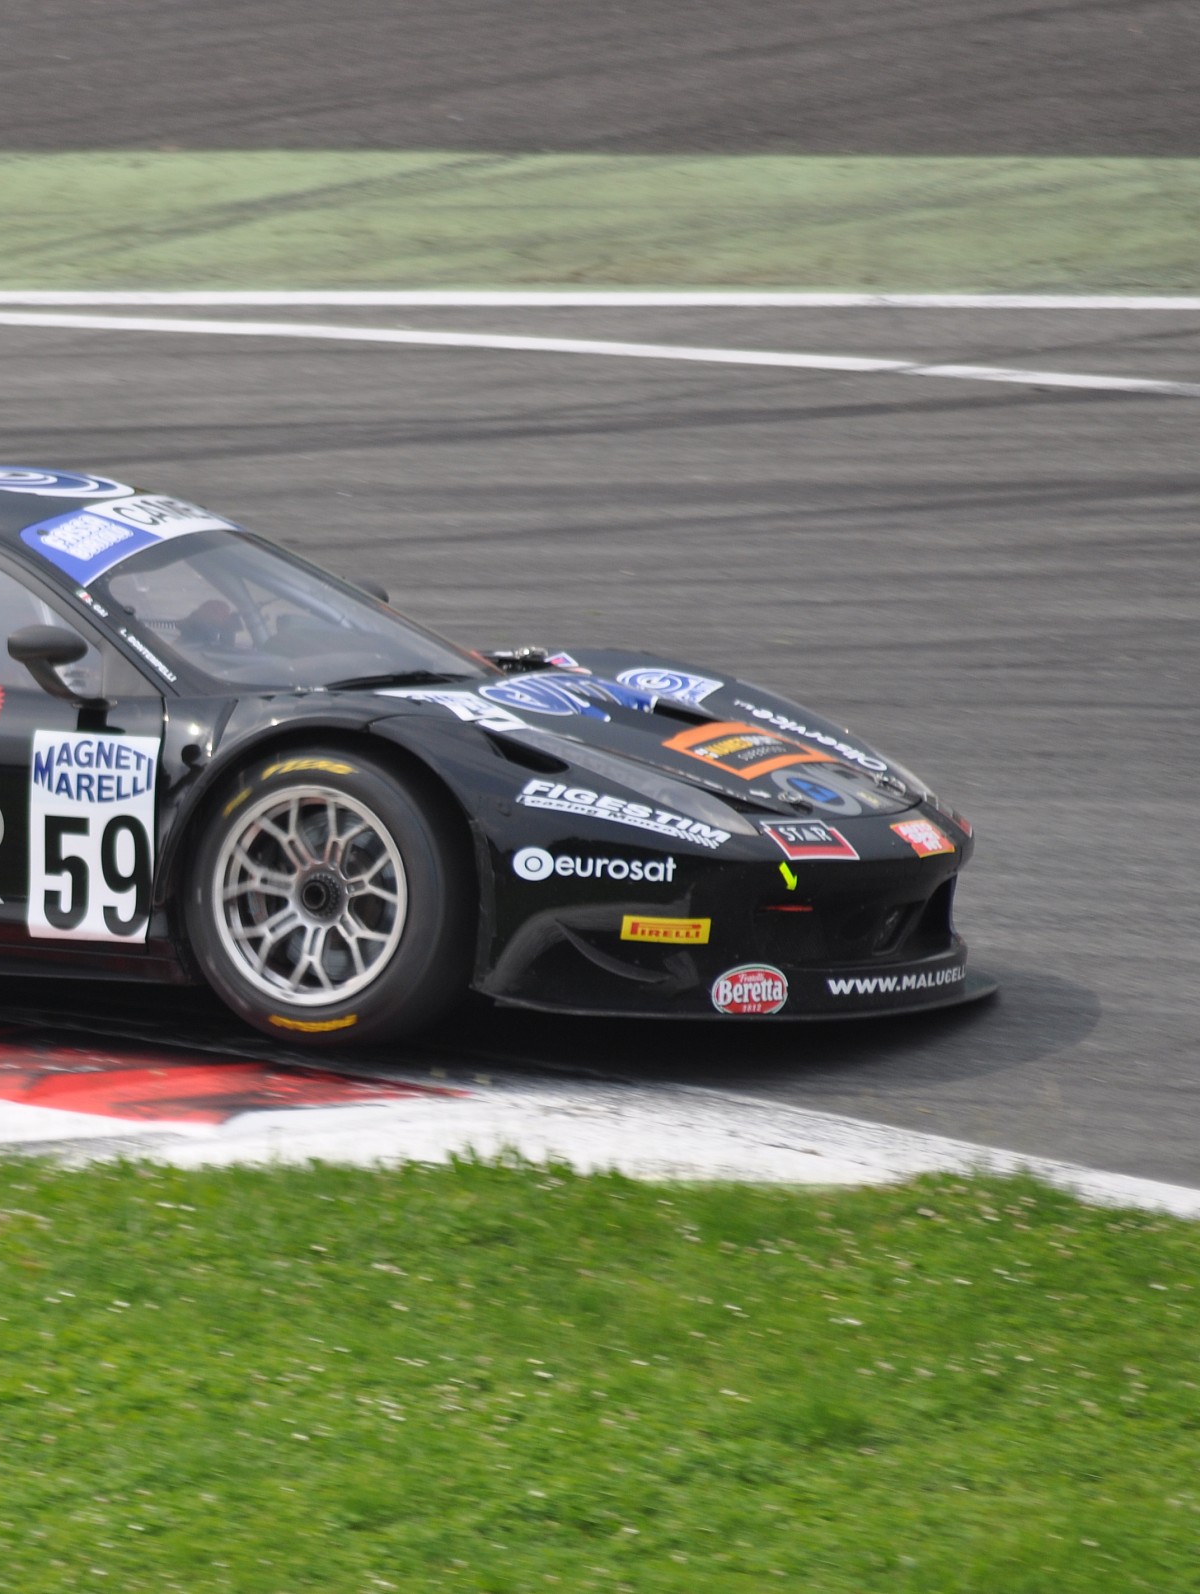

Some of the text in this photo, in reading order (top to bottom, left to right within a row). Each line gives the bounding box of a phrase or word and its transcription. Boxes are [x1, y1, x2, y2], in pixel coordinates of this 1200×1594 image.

[34, 740, 153, 786] MAGNETI
[34, 757, 153, 803] MARELLI
[522, 779, 731, 843] FIGESTIM
[779, 826, 833, 842] STAR
[44, 814, 151, 937] 59
[555, 855, 677, 882] eurosat
[630, 922, 702, 939] PIRELLI
[718, 980, 783, 1006] Beretta
